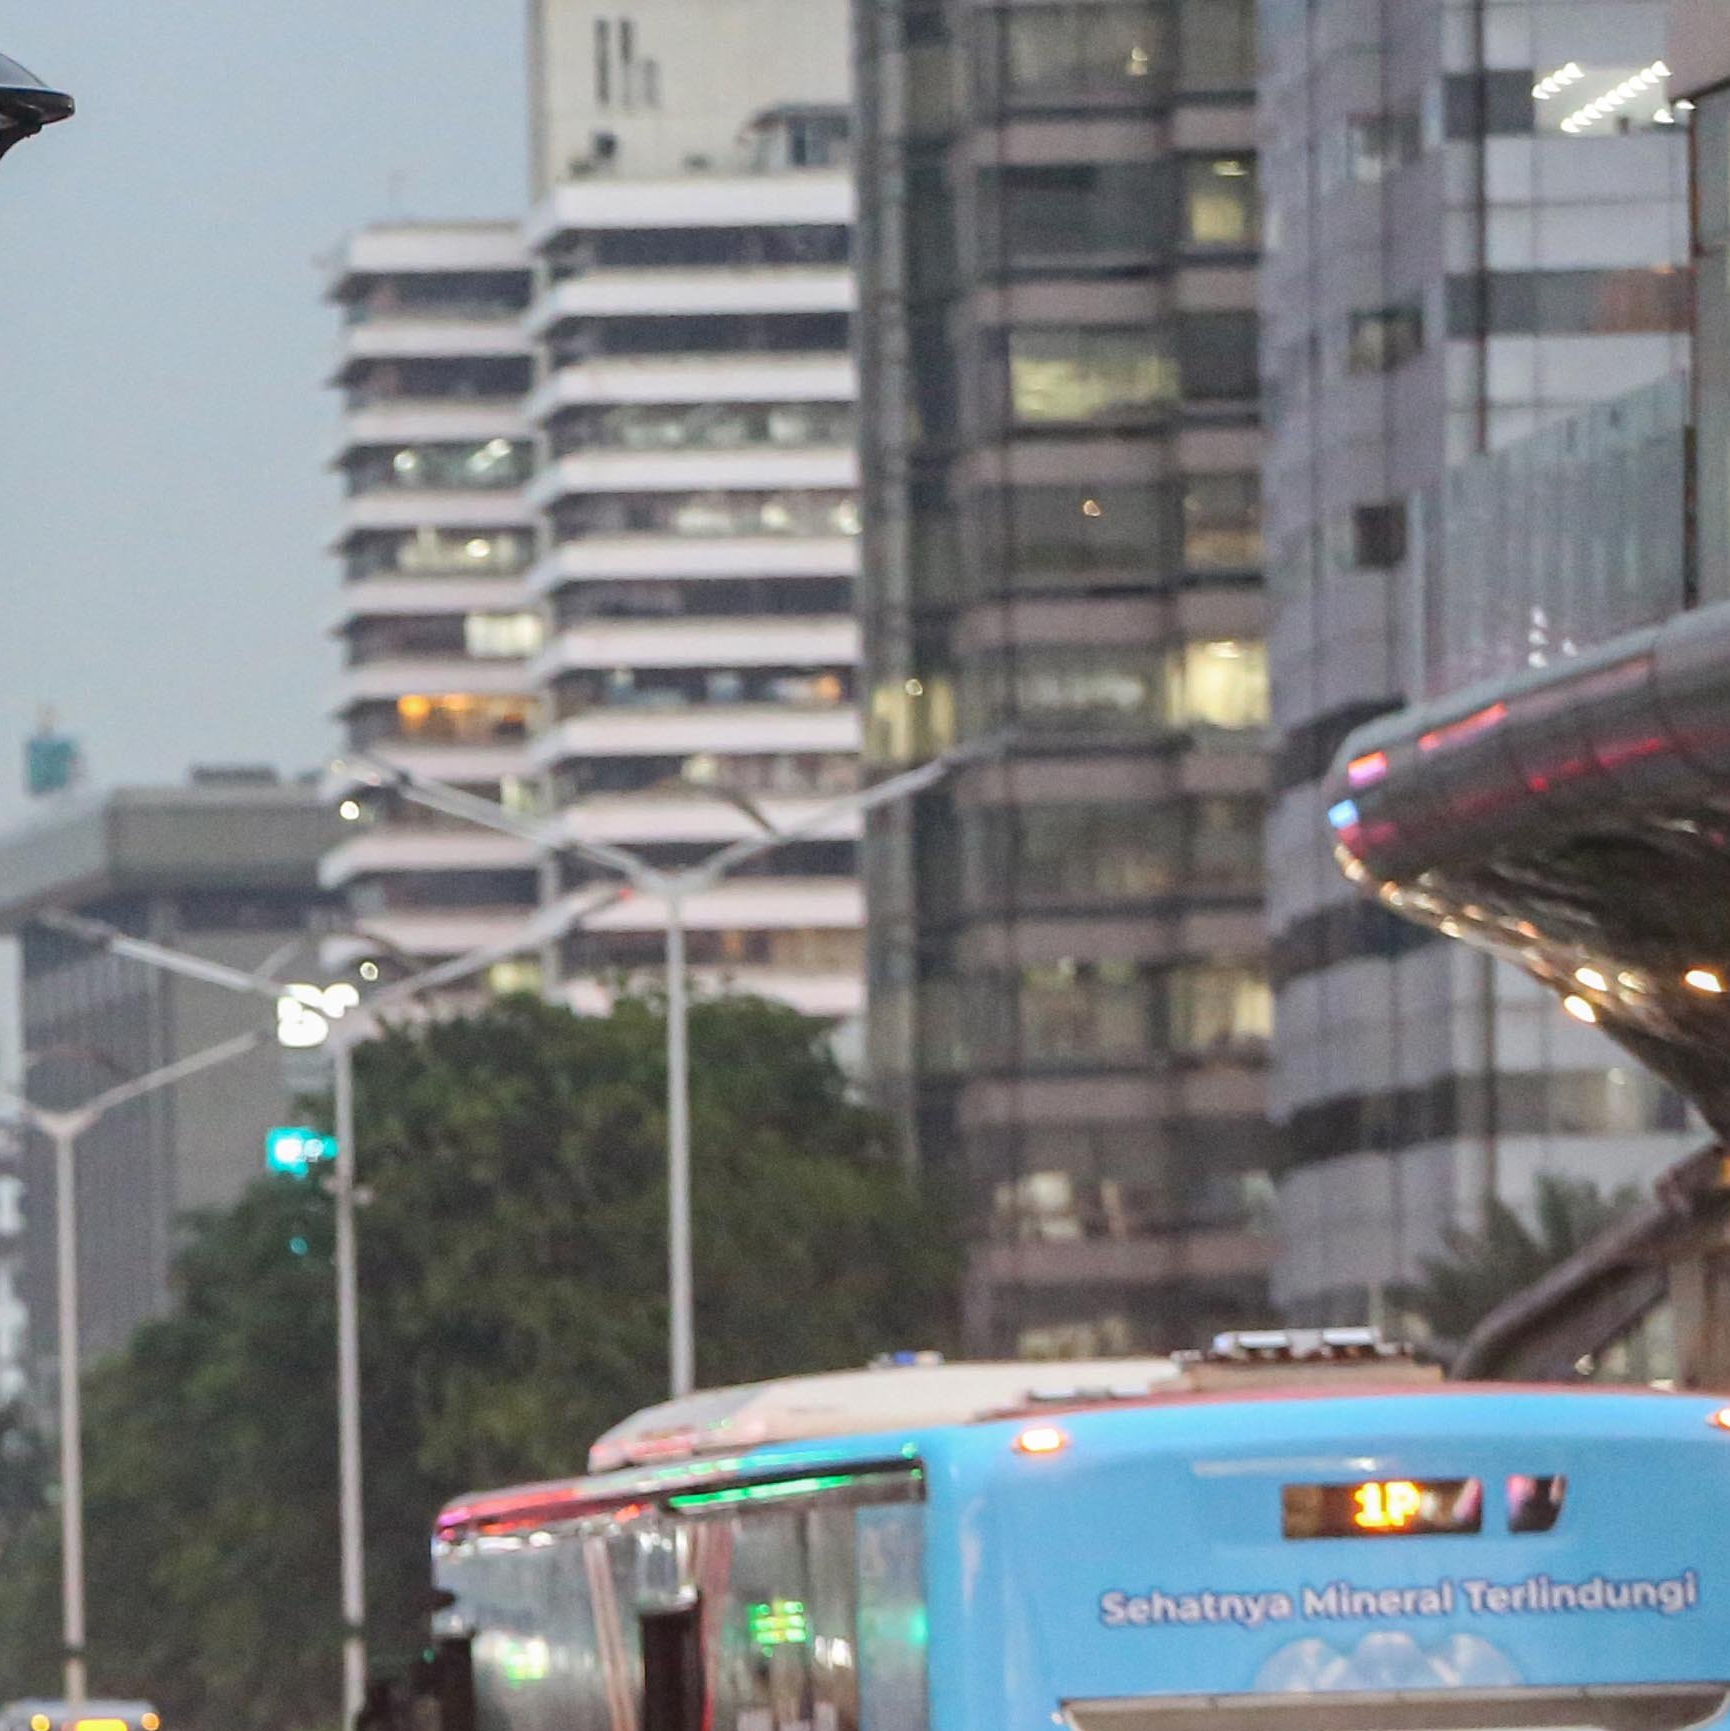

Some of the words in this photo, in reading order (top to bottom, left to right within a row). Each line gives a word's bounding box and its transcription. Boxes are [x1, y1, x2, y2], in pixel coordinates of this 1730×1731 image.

[1100, 1590, 1292, 1627] Sehatnya
[1301, 1582, 1453, 1617] Mineral
[1463, 1571, 1697, 1615] Terlindungi
